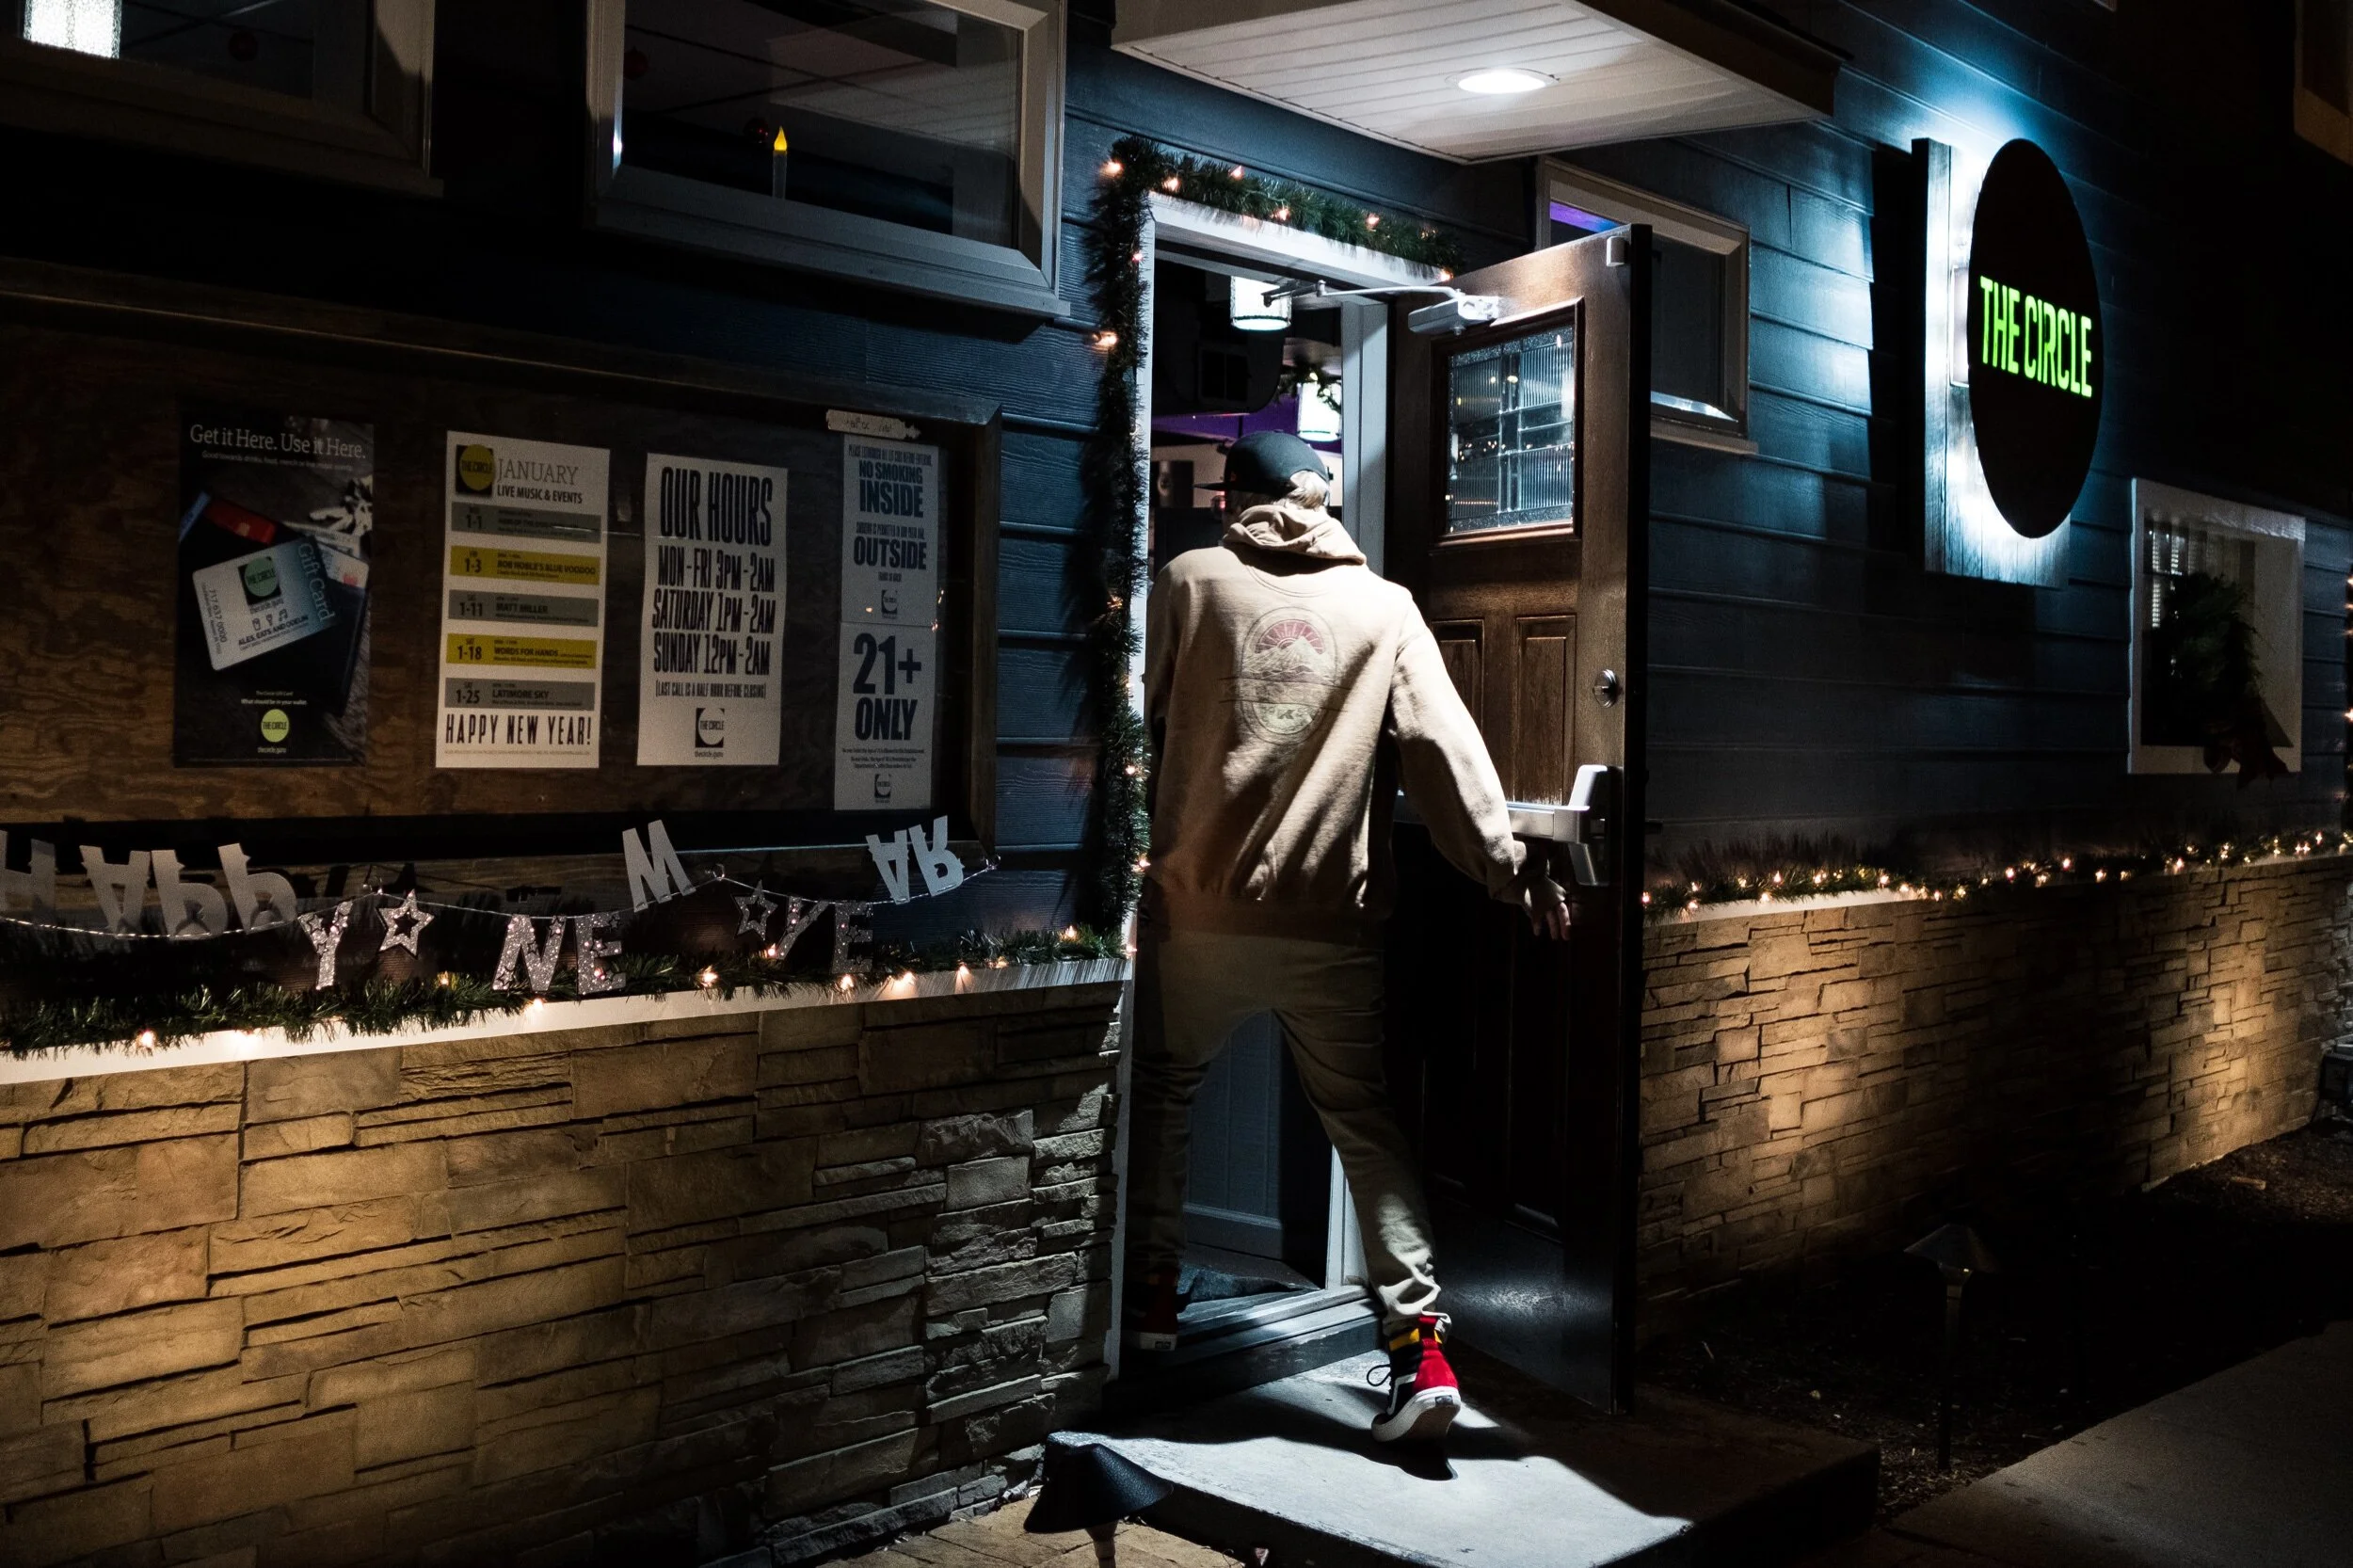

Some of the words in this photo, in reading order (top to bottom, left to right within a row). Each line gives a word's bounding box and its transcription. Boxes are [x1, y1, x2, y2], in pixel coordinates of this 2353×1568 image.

[1980, 275, 2020, 375] THE
[2025, 296, 2091, 397] CIRCLE
[190, 424, 218, 445] Get
[222, 427, 233, 446] it
[235, 428, 278, 451] Here.
[280, 433, 311, 454] Use
[312, 436, 324, 455] it
[326, 438, 366, 459] Here.
[497, 458, 579, 486] JANUARY
[858, 459, 873, 478] NO
[875, 461, 922, 484] SMOKING
[497, 485, 515, 497] LIVE
[518, 486, 542, 501] MUSIC
[544, 489, 551, 501] &
[552, 491, 583, 504] EVENTS
[859, 479, 924, 518] INSIDE
[660, 466, 702, 540] OUR
[707, 472, 774, 547] HOURS
[467, 515, 483, 529] 1-1
[853, 536, 926, 570] OUTSIDE
[465, 557, 482, 574] 1-3
[544, 563, 565, 572] BLUE
[565, 565, 596, 575] VOODOO
[298, 543, 320, 576] Gift
[310, 578, 336, 622] Card
[459, 601, 484, 617] 1-11
[495, 602, 518, 612] MATT
[520, 604, 548, 614] MILLER
[651, 588, 715, 632] SATURDAY
[457, 646, 482, 661] 1-18
[494, 647, 520, 655] WORDS
[520, 648, 535, 656] FOR
[653, 632, 701, 674] SUNDAY
[853, 632, 921, 695] 21+
[456, 689, 480, 704] 1-25
[492, 689, 533, 698] LATIMORE
[534, 691, 550, 699] SKY
[672, 681, 683, 696] CALL
[685, 682, 691, 696] IS
[696, 682, 710, 697] HALF
[725, 683, 742, 698] BEFORE
[263, 722, 271, 730] THE
[272, 722, 287, 730] CIRCLE
[445, 713, 498, 744] HAPPY
[506, 715, 538, 744] NEW
[548, 715, 591, 745] YEAR!
[709, 721, 725, 730] CIRCLE
[855, 696, 918, 741] ONLY
